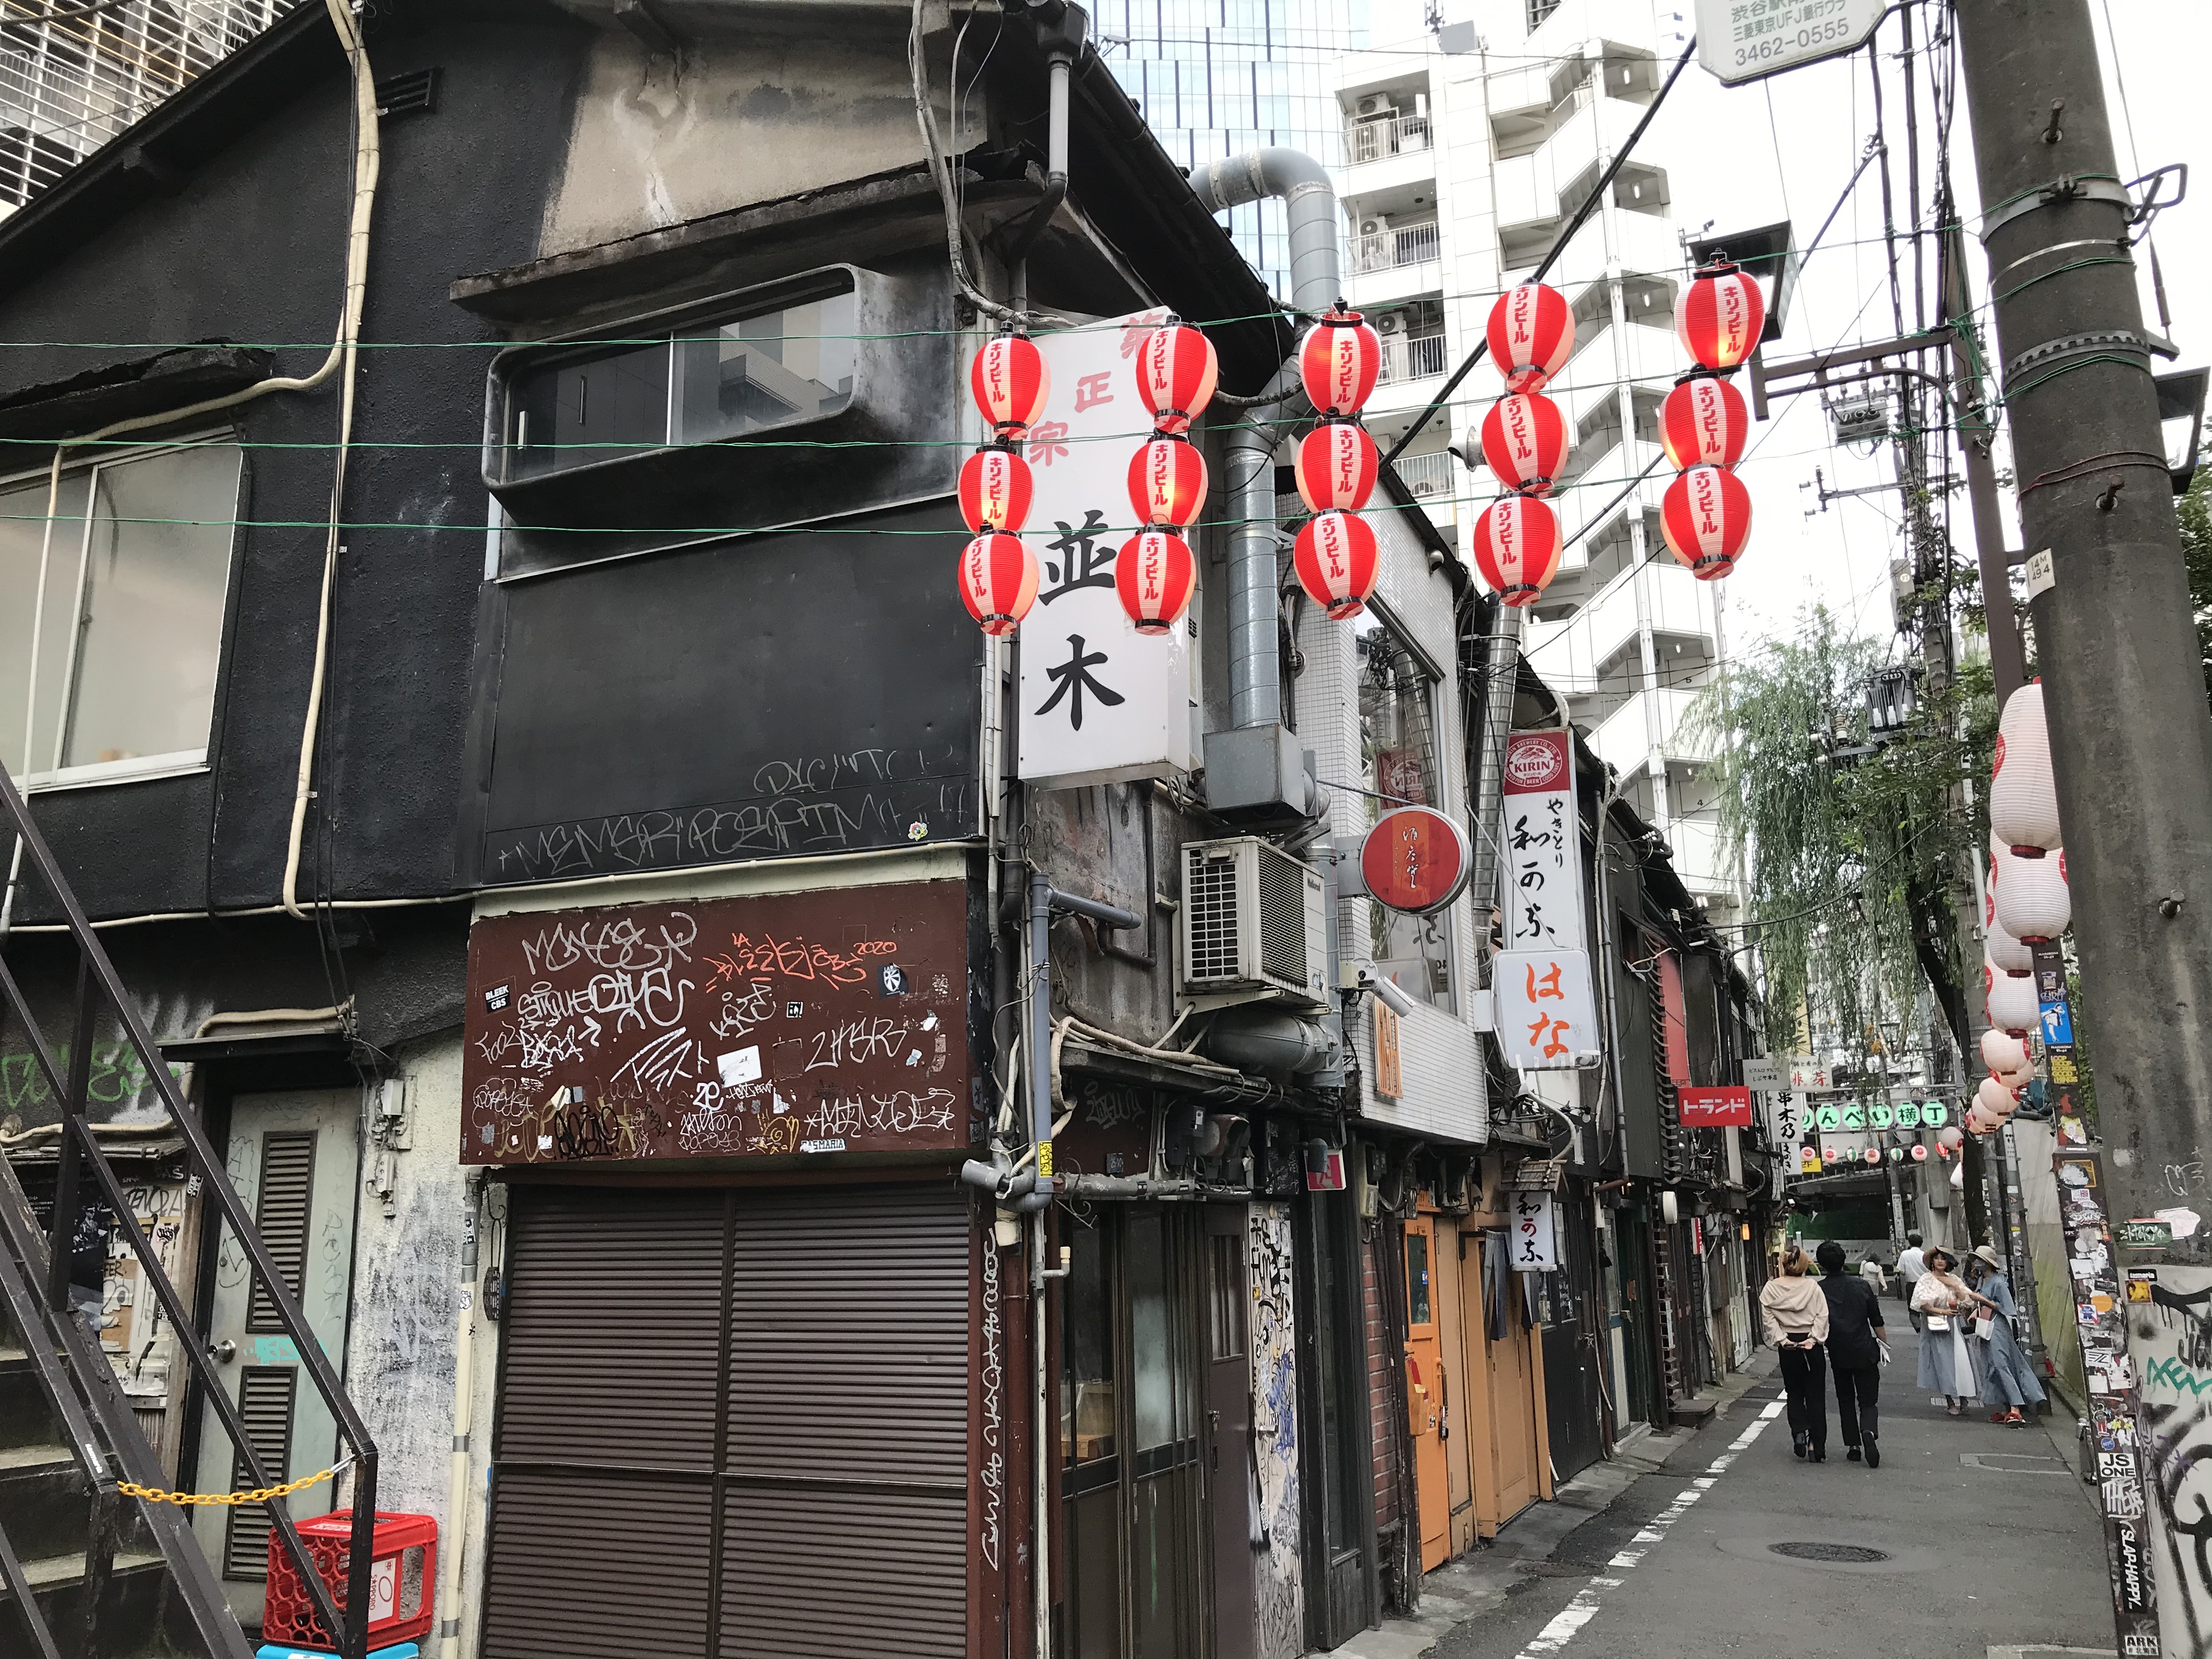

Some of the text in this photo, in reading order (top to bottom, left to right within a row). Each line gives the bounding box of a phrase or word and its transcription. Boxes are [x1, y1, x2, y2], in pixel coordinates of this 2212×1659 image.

[1735, 17, 1849, 66] 3462-0555
[1513, 286, 1530, 344] キリンビール
[1725, 286, 1742, 353] キリンビール
[990, 342, 1006, 403] キリンビール
[1154, 330, 1169, 390] キリンビール
[1336, 341, 1353, 403] キリンビール
[1506, 397, 1533, 460] キリンビール
[1698, 386, 1720, 454] キリンビール
[988, 456, 1002, 520] キリンビール
[1154, 444, 1169, 506] キリンビール
[1337, 425, 1353, 493] キリンビール
[1498, 502, 1516, 565] キリンビール
[1695, 472, 1718, 534] キリンビール
[971, 538, 986, 597] キリンビール
[1144, 536, 1159, 600] キリンビール
[1322, 517, 1344, 579] キリンビール
[2031, 554, 2047, 571] 14M
[1034, 509, 1125, 731] 並木
[1514, 760, 1550, 773] KIRIN
[1516, 739, 1539, 748] BREWERY
[1547, 798, 1563, 868] やきとり
[853, 941, 898, 955] 2020
[485, 985, 509, 1001] BLEEK
[490, 1000, 506, 1010] CBS
[1526, 961, 1570, 1059] はな
[1683, 1098, 1746, 1115] トランド
[1777, 1092, 1797, 1139] 串木乃
[2101, 1467, 2136, 1477] ONE
[2104, 1454, 2130, 1467] JS
